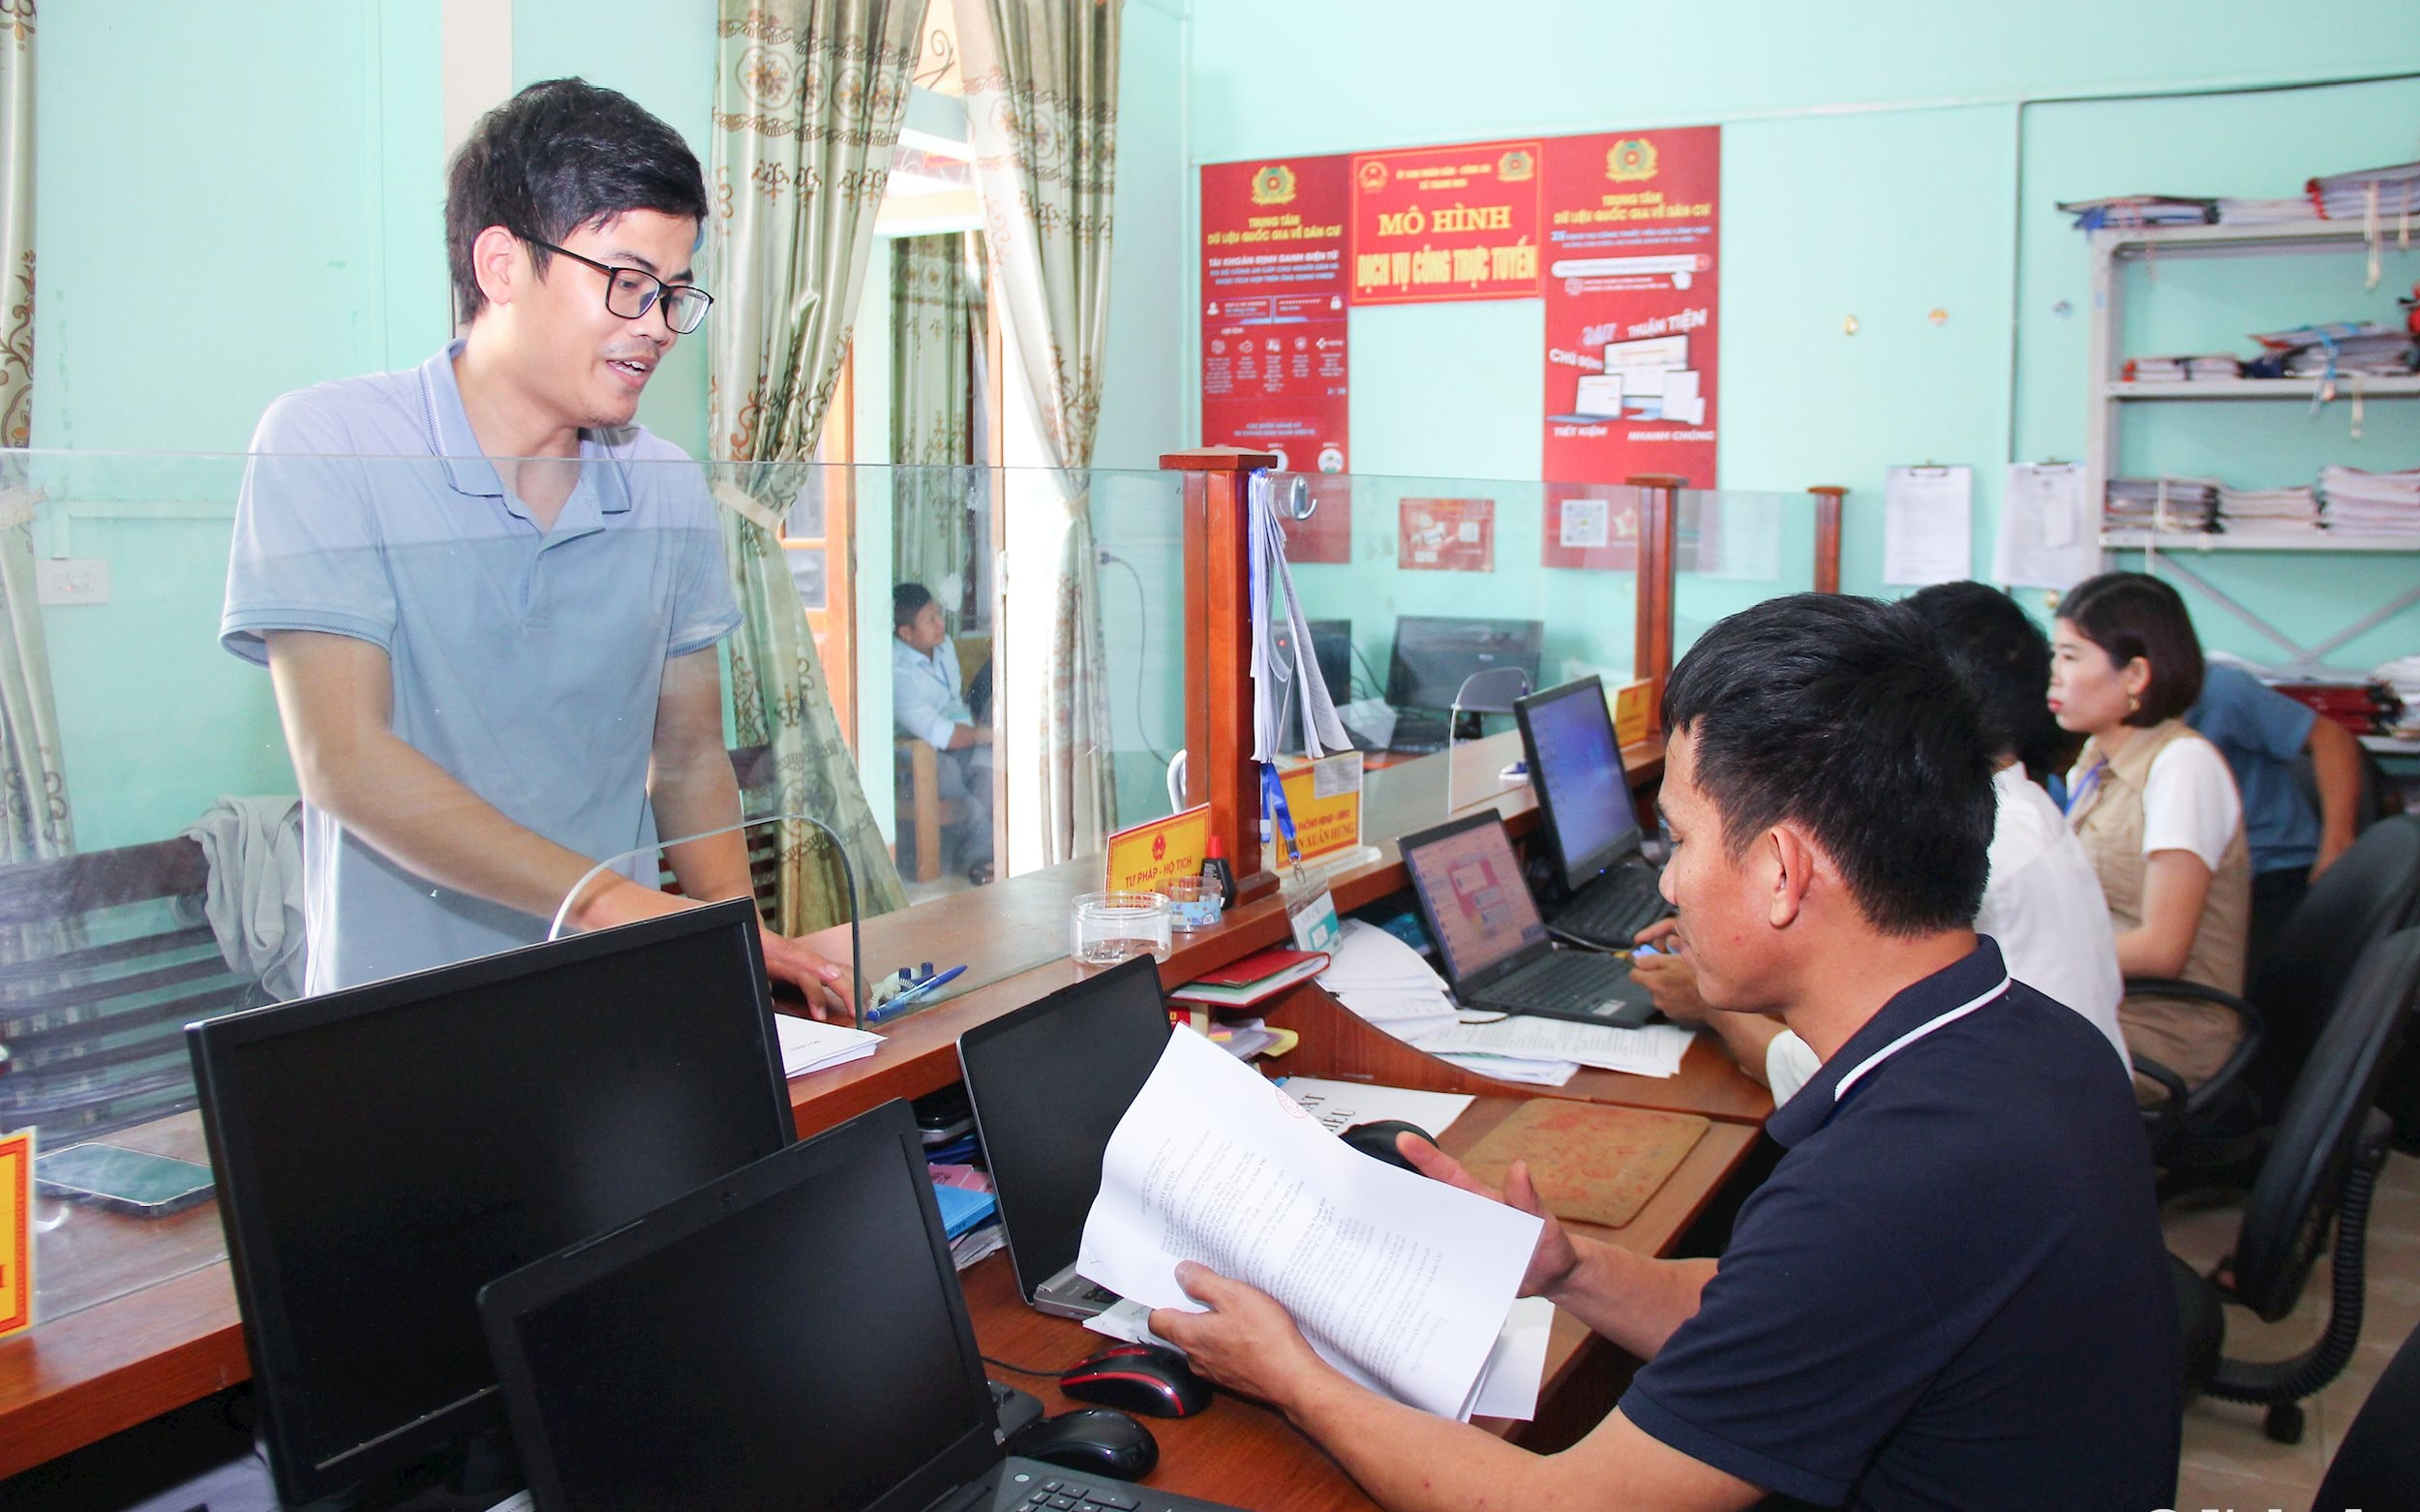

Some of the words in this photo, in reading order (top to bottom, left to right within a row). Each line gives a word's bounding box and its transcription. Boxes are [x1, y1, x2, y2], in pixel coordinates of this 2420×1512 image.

[1377, 204, 1426, 236] MÔ
[1431, 201, 1512, 232] HÌNH
[1357, 253, 1390, 293] DỊCH
[1391, 251, 1411, 292] VỤ
[1412, 243, 1451, 284] CÔNG
[1452, 244, 1490, 289] TRỰC
[1491, 234, 1537, 281] TUYẾN
[1667, 308, 1709, 331] TIỆN
[1548, 348, 1577, 364] CHỦ
[1125, 874, 1136, 890] TƯ
[1164, 861, 1175, 875] HỘ
[1176, 856, 1193, 871] TỊCH
